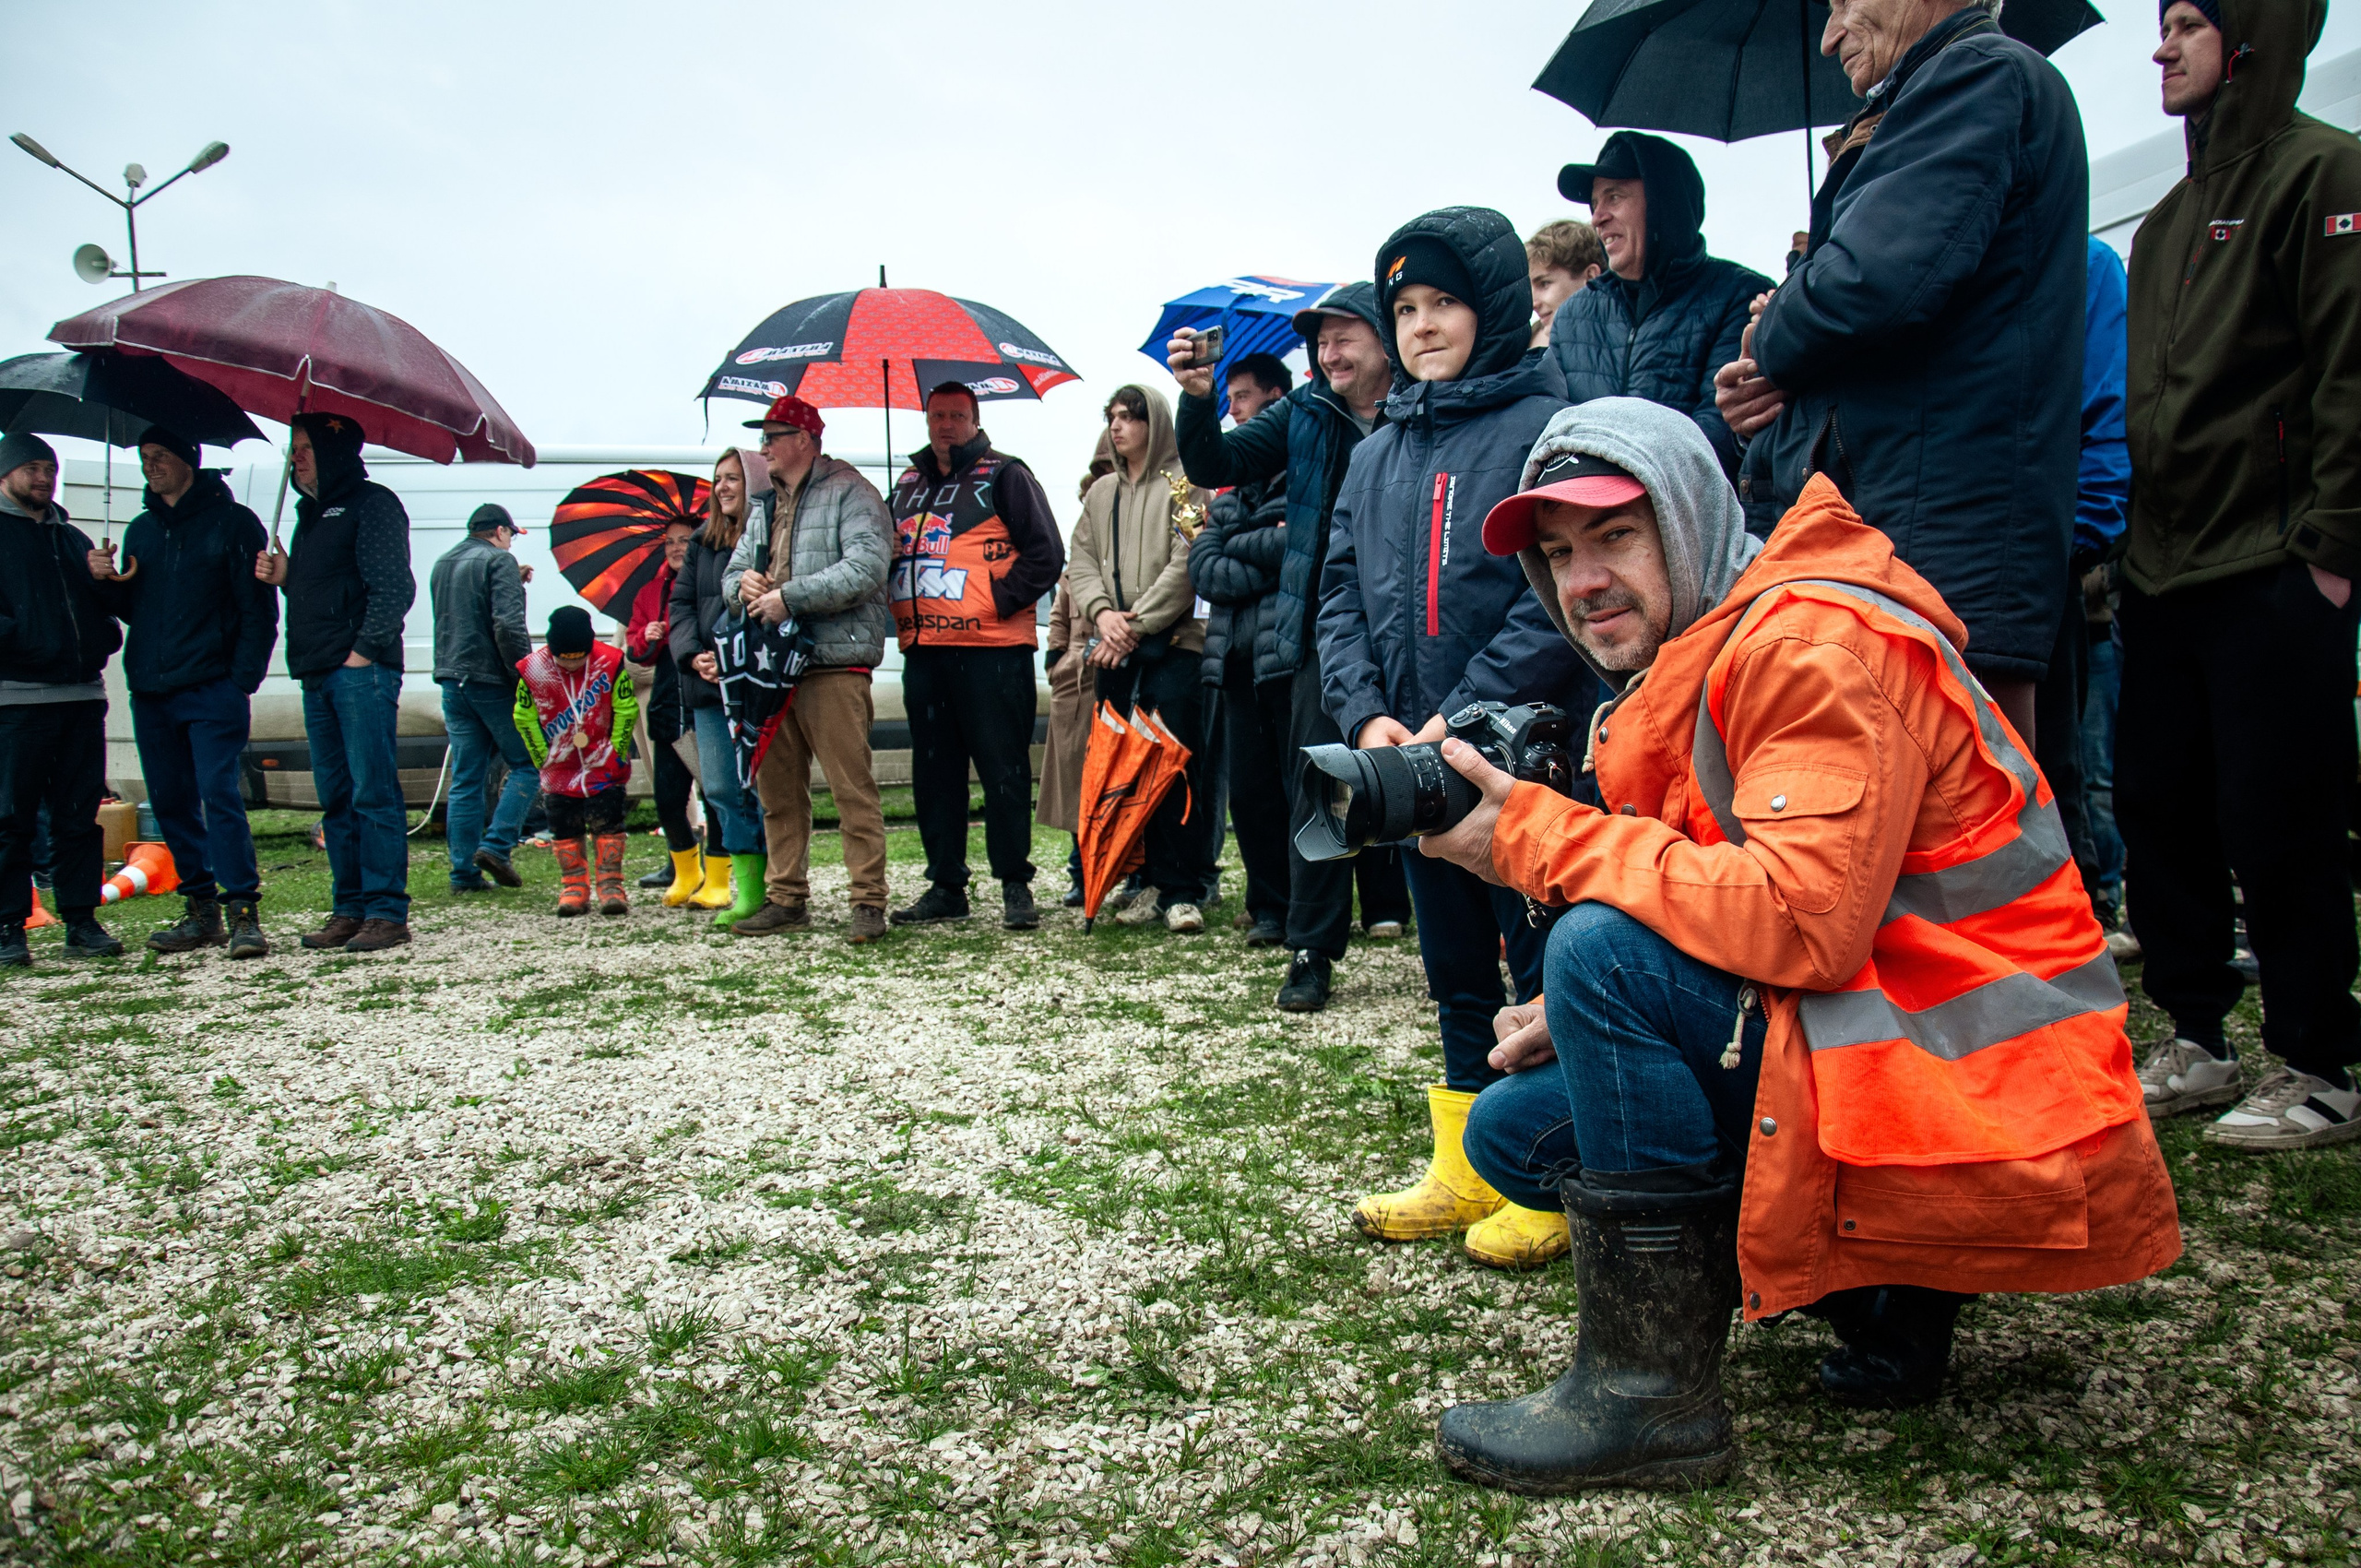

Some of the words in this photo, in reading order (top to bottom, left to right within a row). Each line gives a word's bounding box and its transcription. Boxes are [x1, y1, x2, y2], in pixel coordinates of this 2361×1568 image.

[891, 481, 991, 508] THOR
[915, 535, 949, 554] Bull
[1442, 530, 1451, 565] LIMITS
[897, 614, 980, 633] seaspan
[1499, 717, 1517, 735] Nikon
[1525, 752, 1532, 760] Z
